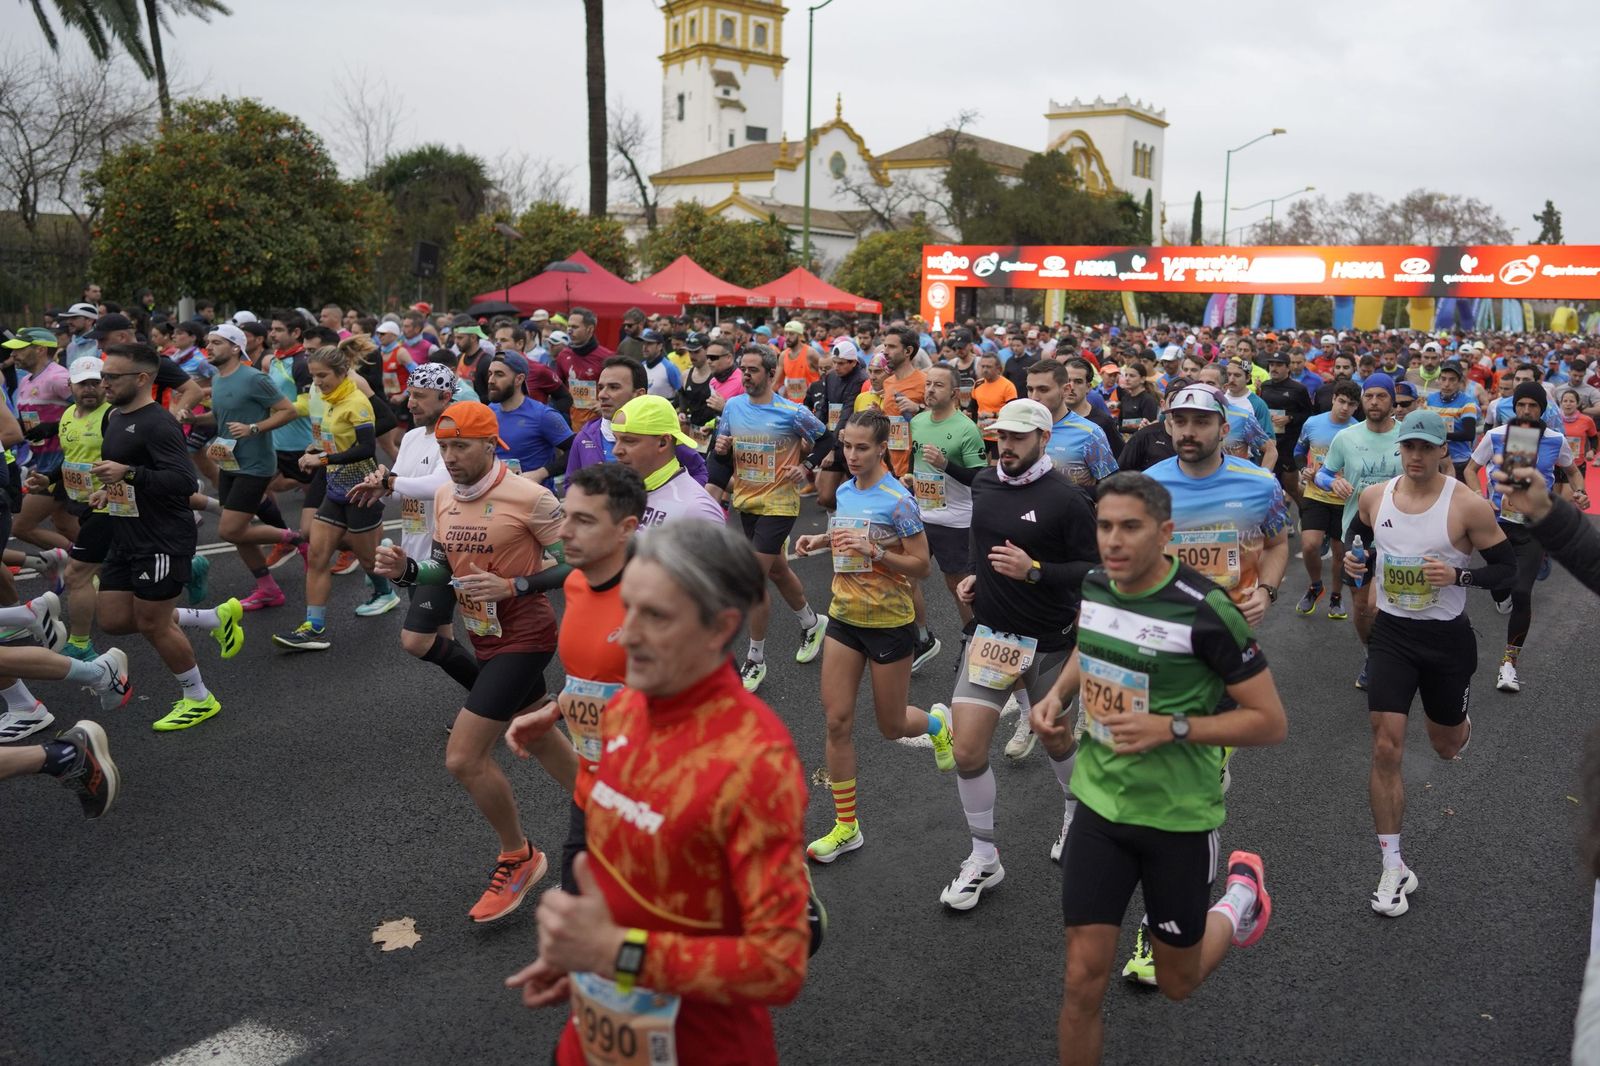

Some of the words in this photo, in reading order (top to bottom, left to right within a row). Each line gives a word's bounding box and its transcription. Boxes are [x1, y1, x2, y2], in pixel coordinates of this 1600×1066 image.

[740, 452, 764, 465] 4301
[445, 531, 487, 542] CIUDAD
[456, 543, 494, 553] ZAFRA
[1177, 547, 1221, 566] 5097
[1388, 568, 1426, 586] 9904
[980, 642, 1021, 666] 8088
[568, 699, 605, 726] 429
